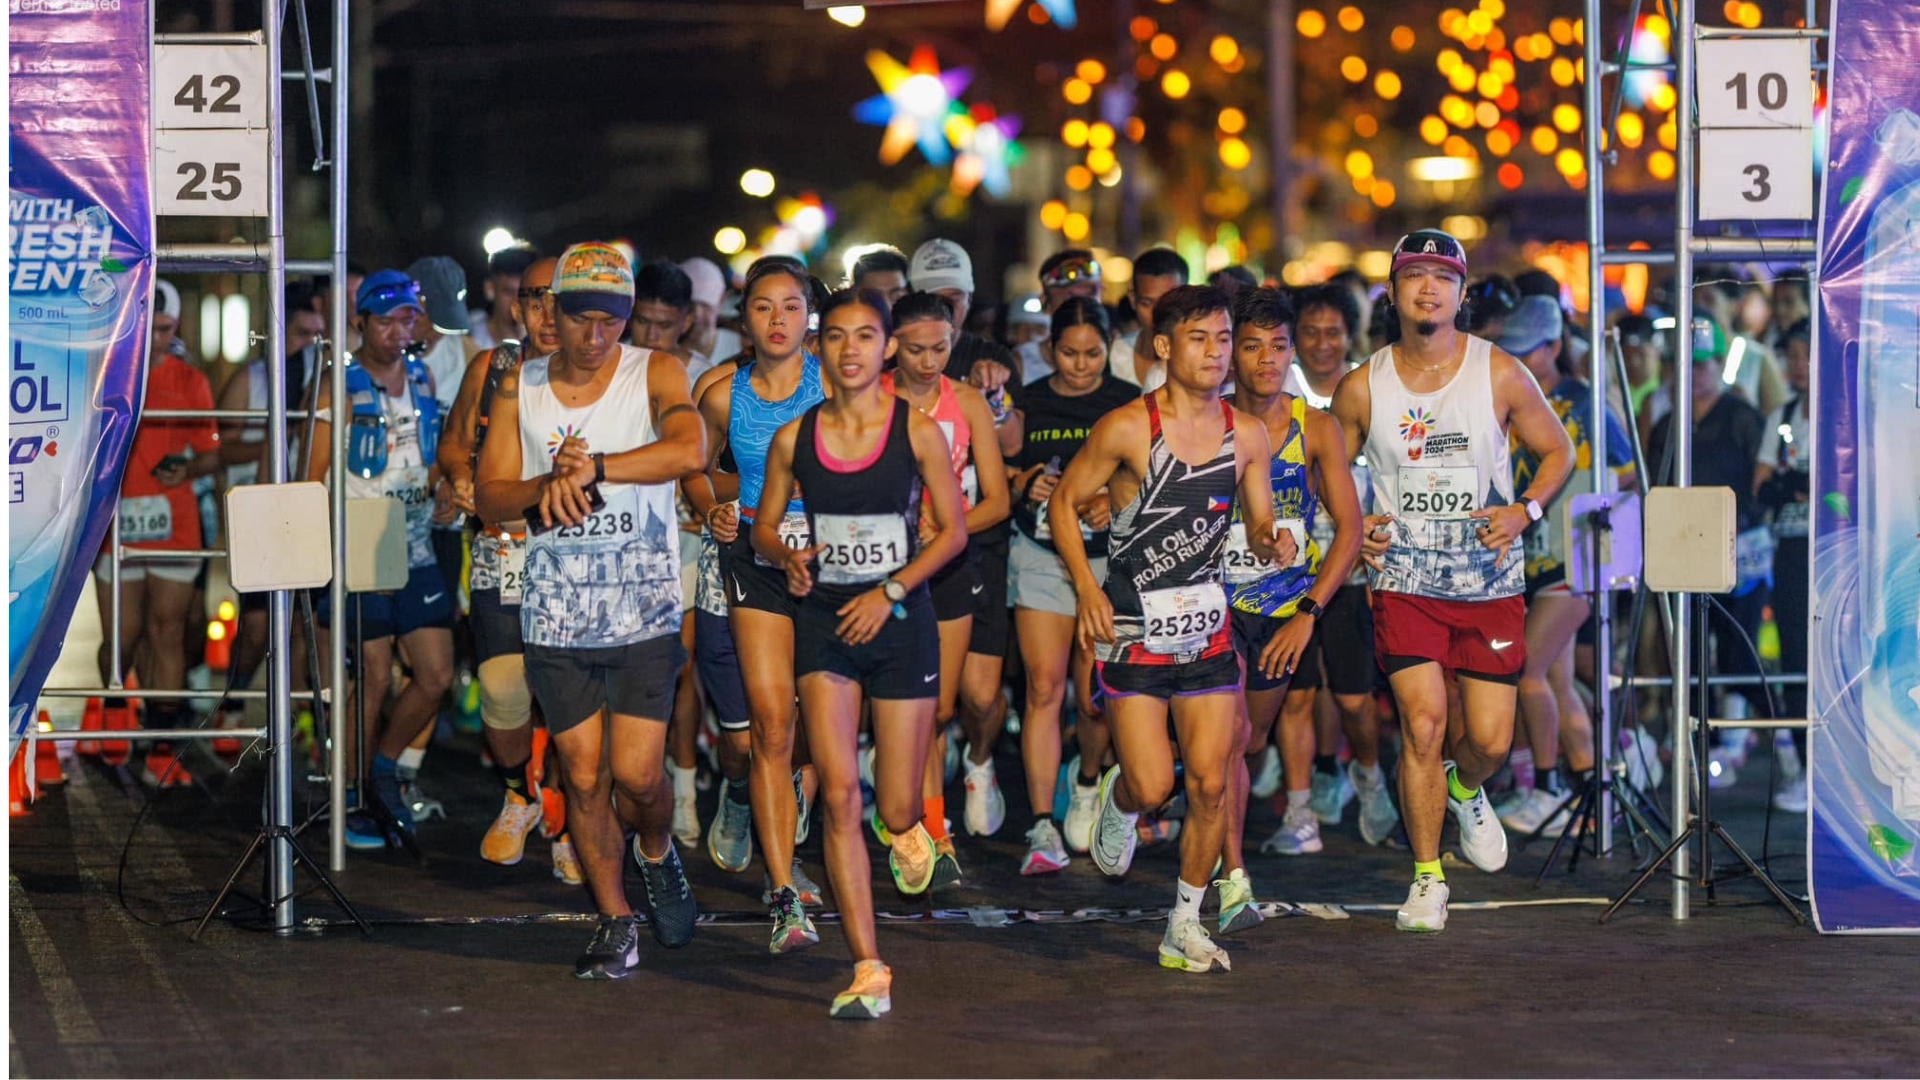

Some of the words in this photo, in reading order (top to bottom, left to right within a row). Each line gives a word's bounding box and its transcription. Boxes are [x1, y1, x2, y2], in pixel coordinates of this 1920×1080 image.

[174, 75, 241, 113] 42
[1725, 72, 1788, 110] 10
[176, 162, 242, 201] 25
[1742, 164, 1771, 203] 3
[9, 199, 74, 221] WITH
[9, 261, 102, 291] ENT
[19, 307, 43, 319] 500
[47, 306, 69, 319] mL
[14, 340, 35, 371] L
[10, 375, 62, 414] OL
[9, 436, 43, 464] O
[1424, 446, 1444, 454] 2024
[1425, 436, 1469, 447] MARATHON
[1402, 492, 1473, 512] 25092
[824, 542, 898, 566] 25051
[1132, 556, 1176, 591] ROAD
[1149, 609, 1220, 636] 25239
